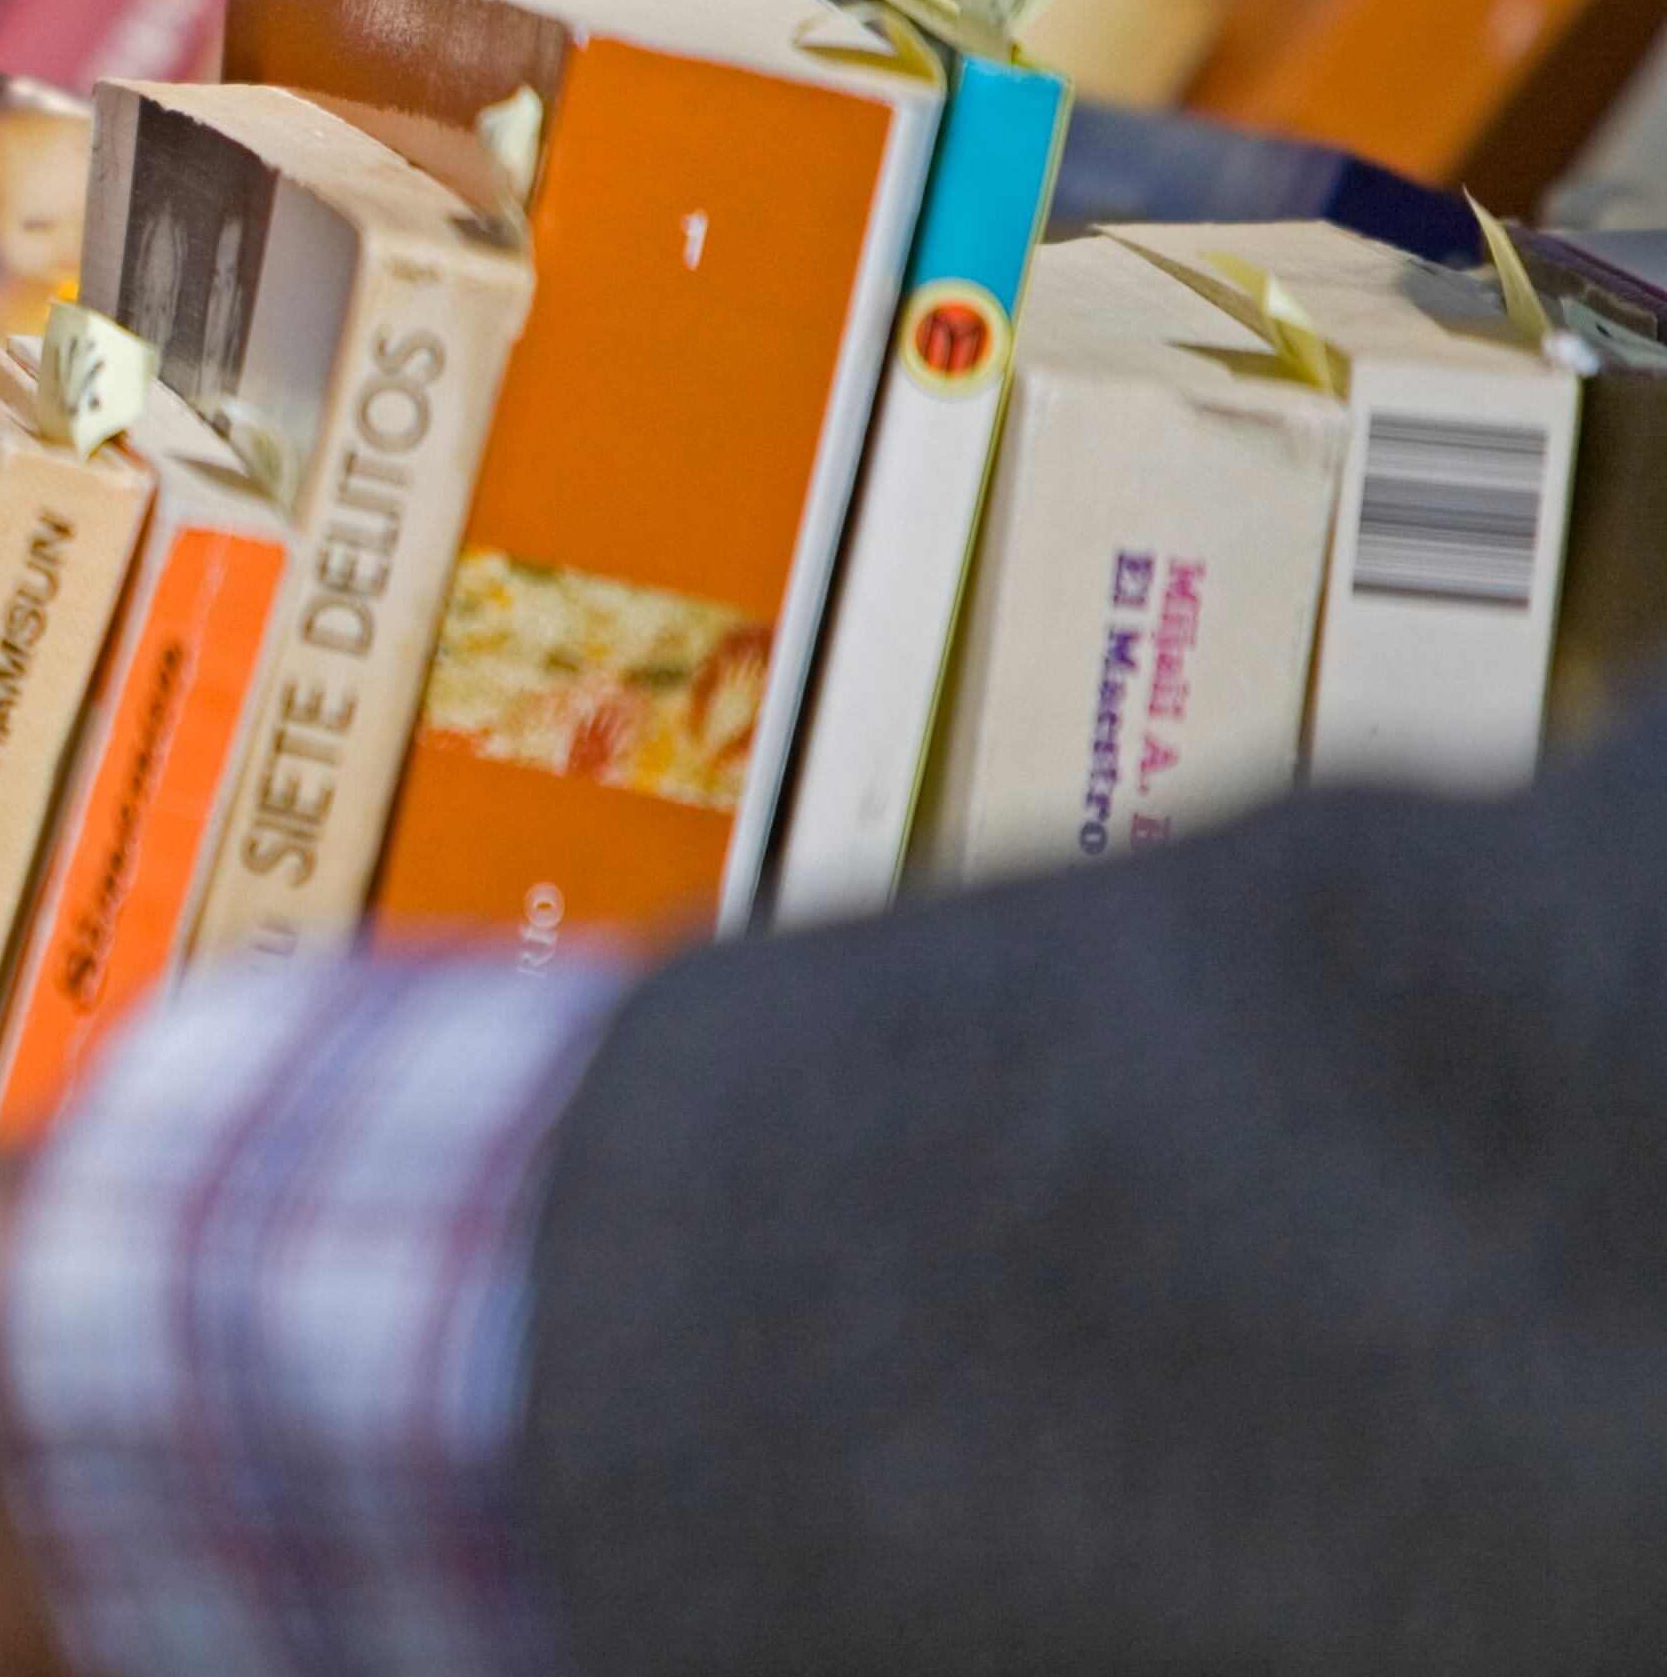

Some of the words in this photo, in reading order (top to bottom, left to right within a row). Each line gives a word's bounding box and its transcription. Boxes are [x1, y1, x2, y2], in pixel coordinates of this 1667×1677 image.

[299, 324, 449, 657] DELITOS
[1113, 551, 1154, 610] El
[241, 674, 361, 890] SIETE
[1078, 626, 1141, 857] Maestro
